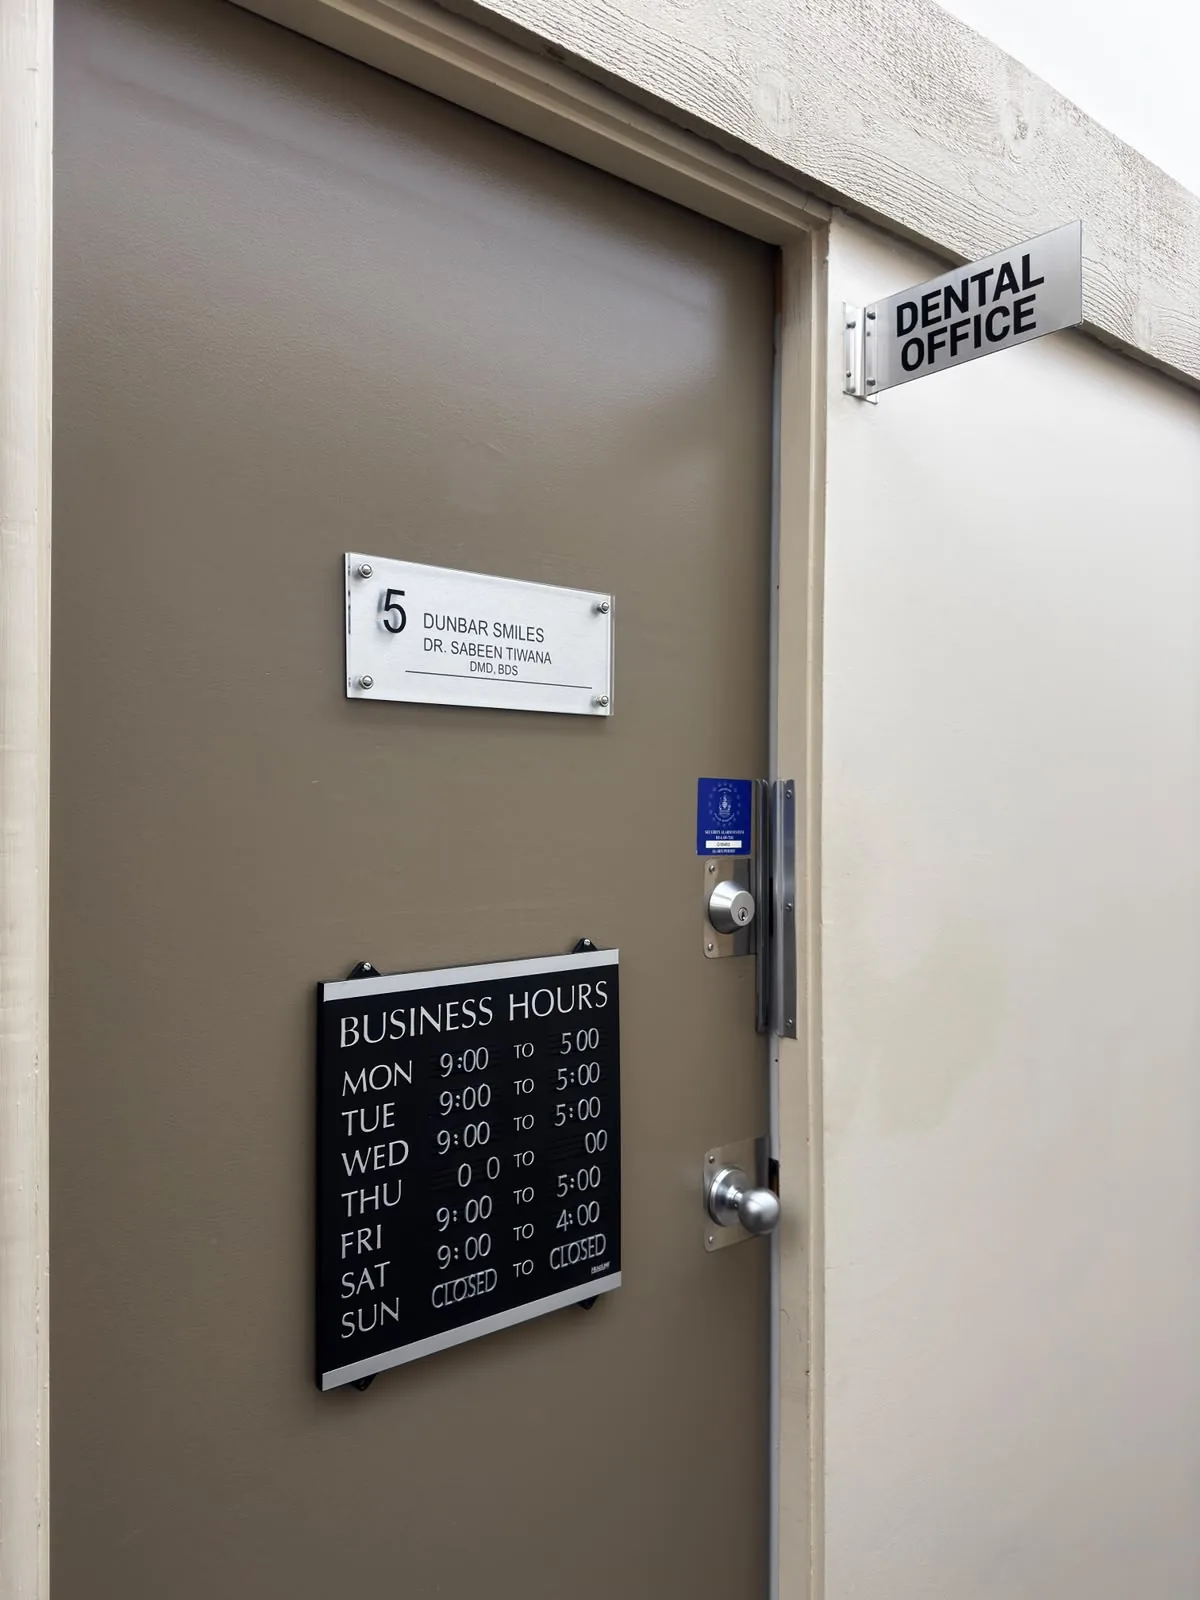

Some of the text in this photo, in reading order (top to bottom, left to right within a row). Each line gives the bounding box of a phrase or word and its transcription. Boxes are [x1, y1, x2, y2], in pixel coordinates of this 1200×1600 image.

[896, 252, 1045, 338] DENTAL
[900, 292, 1037, 373] OFFICE
[383, 587, 408, 634] 5
[423, 612, 545, 643] DUNBAR SMILES
[423, 637, 553, 665] DR. SABEEN TIWANA
[469, 660, 519, 676] DMD, BDS
[339, 980, 608, 1049] BUSINESS HOURS
[341, 1060, 413, 1097] MON
[439, 1046, 489, 1078] 9:00
[512, 1042, 535, 1059] TO
[341, 1061, 601, 1137] TUE 9:00 TO 5:00
[341, 1096, 601, 1177] WED 9:00 TO 5:00
[340, 1165, 601, 1260] FRI 9:00 TO 5:00
[341, 1179, 402, 1218] THU
[512, 1150, 535, 1168] TO
[340, 1200, 601, 1299] SAT 9:00 TO 4:00
[340, 1233, 606, 1339] SUN CLOSED TO CLOSED
